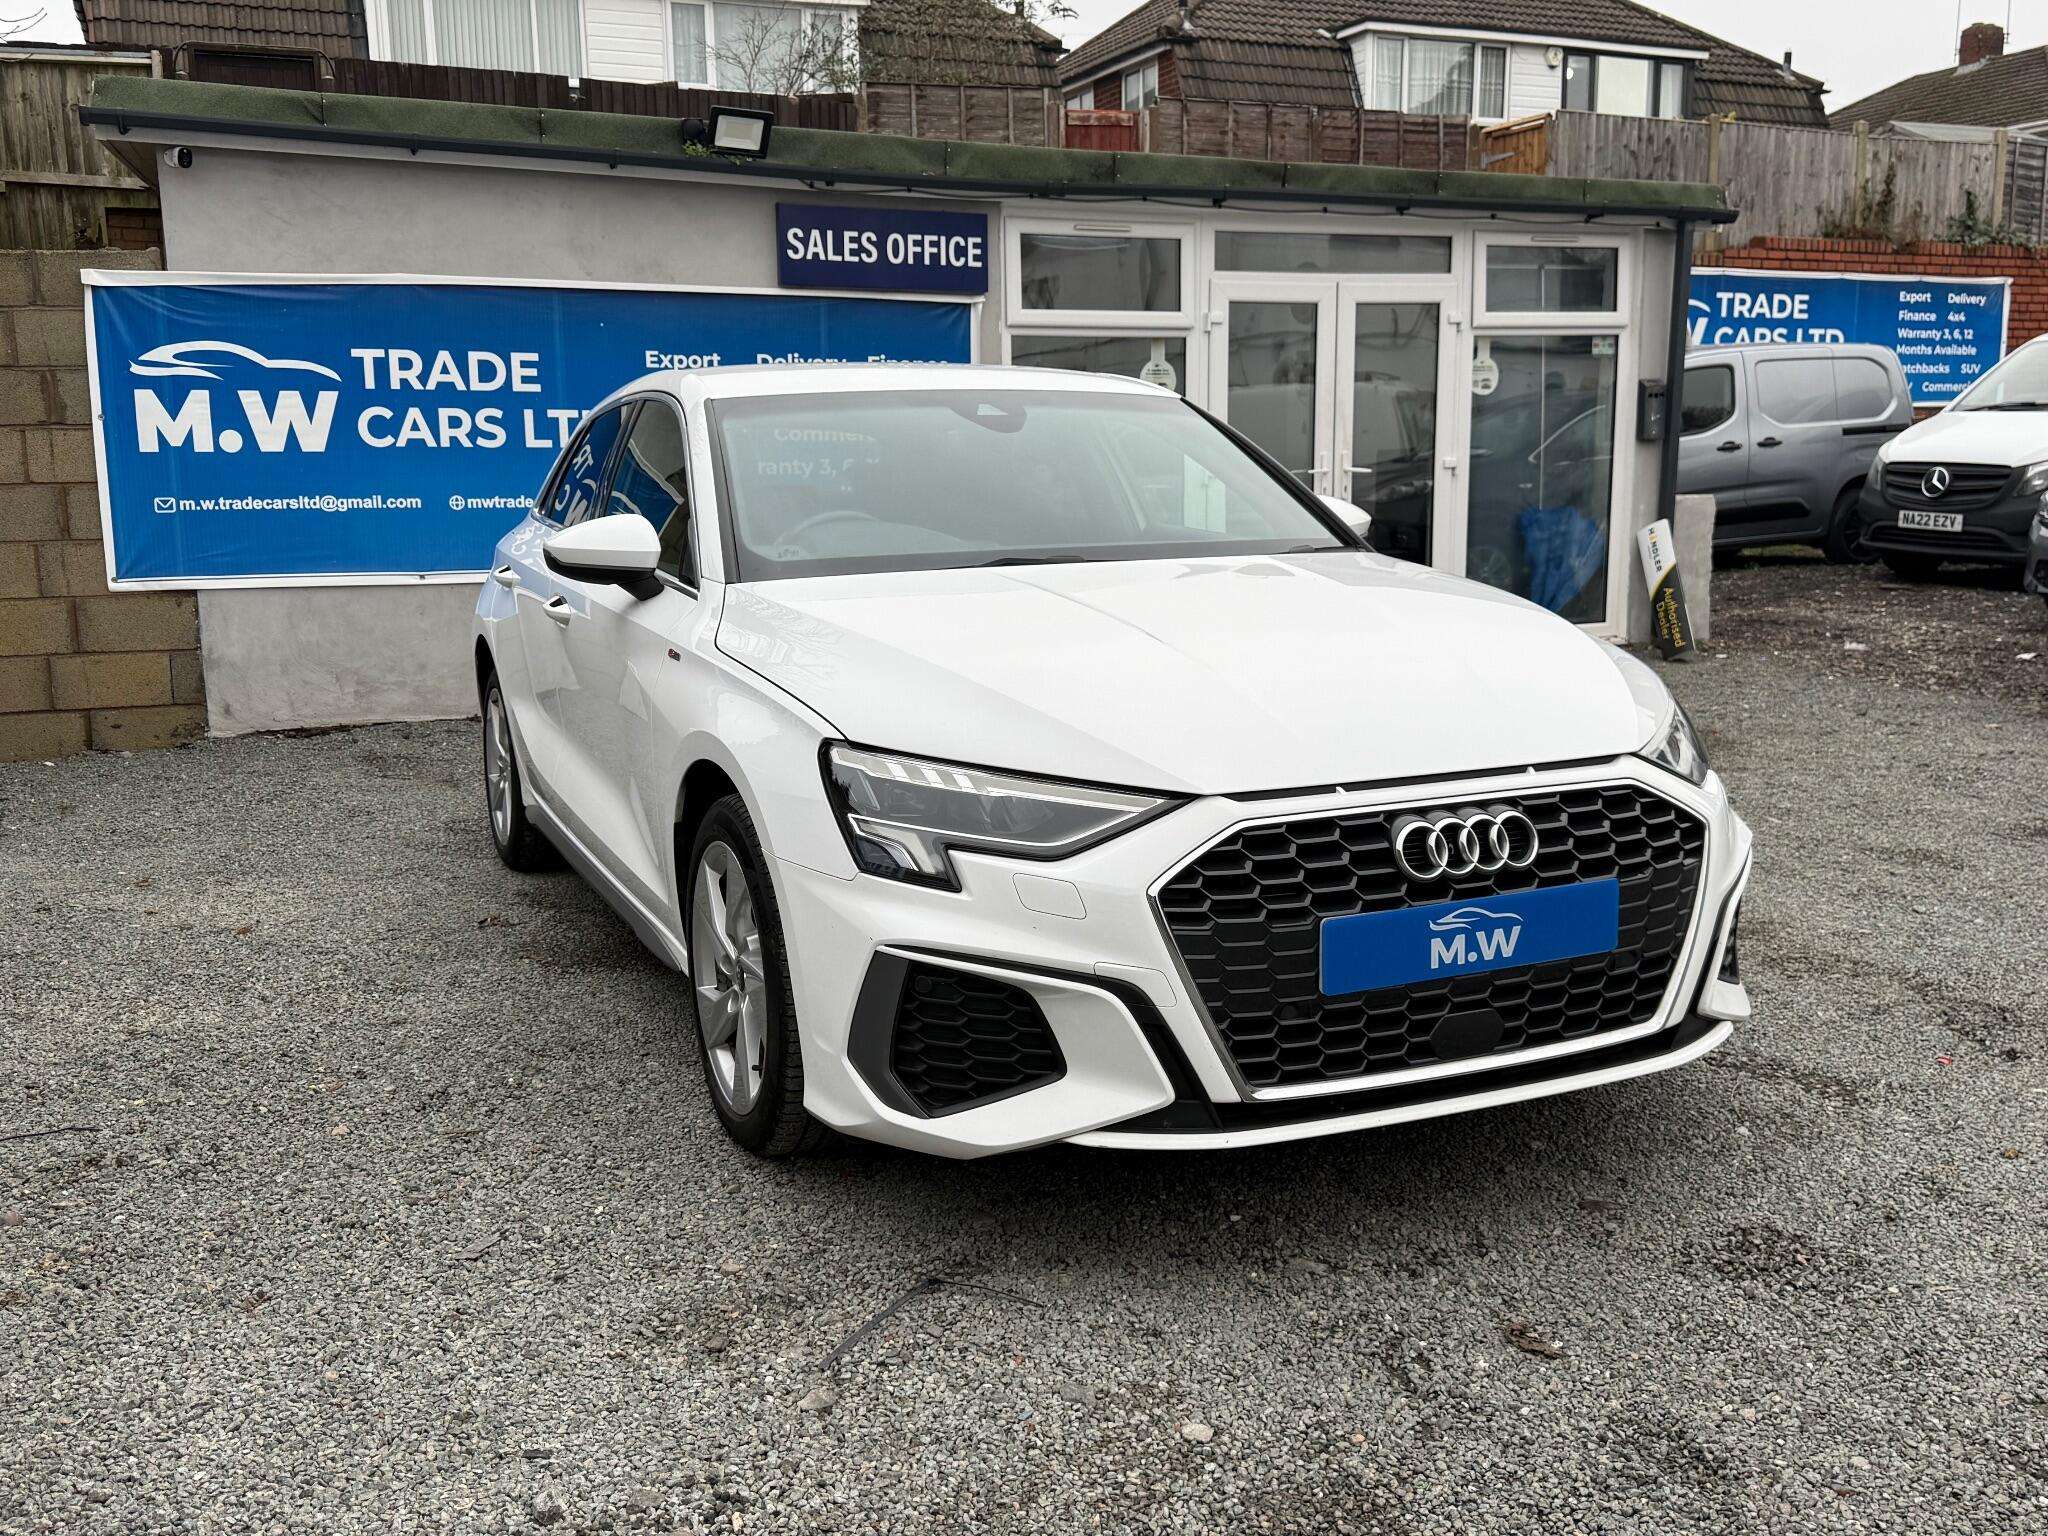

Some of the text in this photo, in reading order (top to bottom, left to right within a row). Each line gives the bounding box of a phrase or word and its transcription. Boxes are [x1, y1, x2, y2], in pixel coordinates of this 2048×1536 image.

[787, 227, 983, 268] SALES OFFICE
[1715, 291, 1810, 320] TRADE
[1899, 291, 1986, 306] Export Delivery
[1898, 310, 1966, 322] Finance 4x4
[1897, 327, 1942, 341] Warranty
[1964, 328, 1974, 340] 12
[645, 350, 721, 371] Export
[1896, 344, 1977, 356] Months Available
[350, 347, 542, 393] TRADE
[1903, 363, 1981, 374] atchbacks SUV
[1922, 382, 1970, 392] Commerc
[133, 388, 339, 454] M.W
[357, 405, 591, 449] CARS LT
[757, 458, 813, 479] ranty
[179, 495, 422, 512] m.w.tradecarsltd@gmail.com
[467, 495, 535, 508] mwtrade
[1903, 512, 1957, 529] NA22 EZV
[1656, 601, 1670, 640] Dealer
[1664, 588, 1686, 648] Authorised
[1430, 925, 1521, 969] M.W
